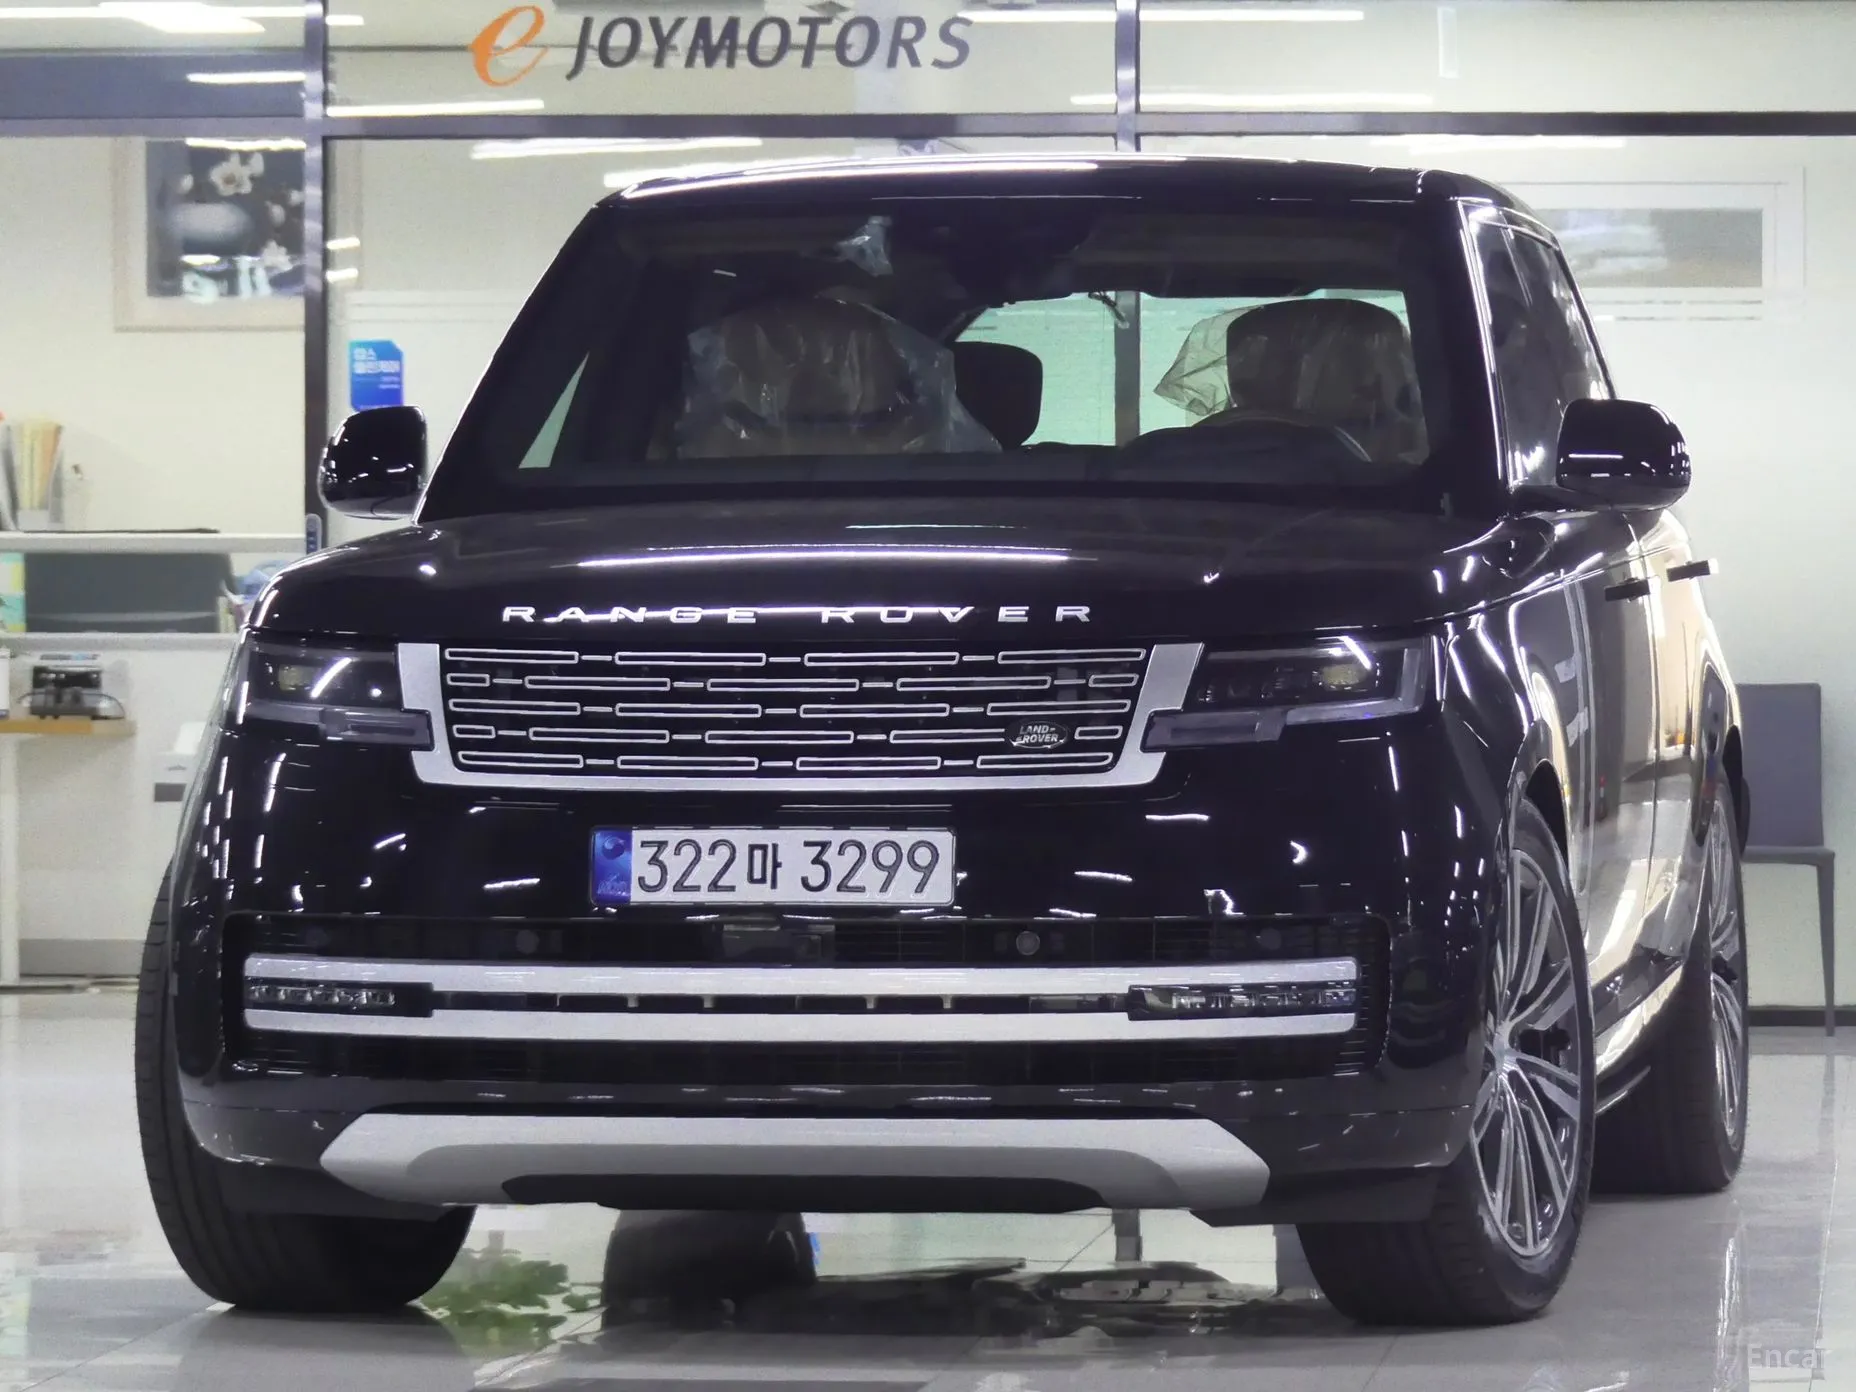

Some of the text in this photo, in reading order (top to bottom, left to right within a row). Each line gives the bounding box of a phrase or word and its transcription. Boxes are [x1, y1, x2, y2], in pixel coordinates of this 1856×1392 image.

[566, 15, 974, 81] JOYMOTORS
[502, 604, 1091, 626] RANGE ROVER
[1020, 725, 1048, 734] LAND
[1022, 733, 1058, 743] ROVER
[637, 839, 782, 892] 322마
[800, 839, 940, 893] 3299
